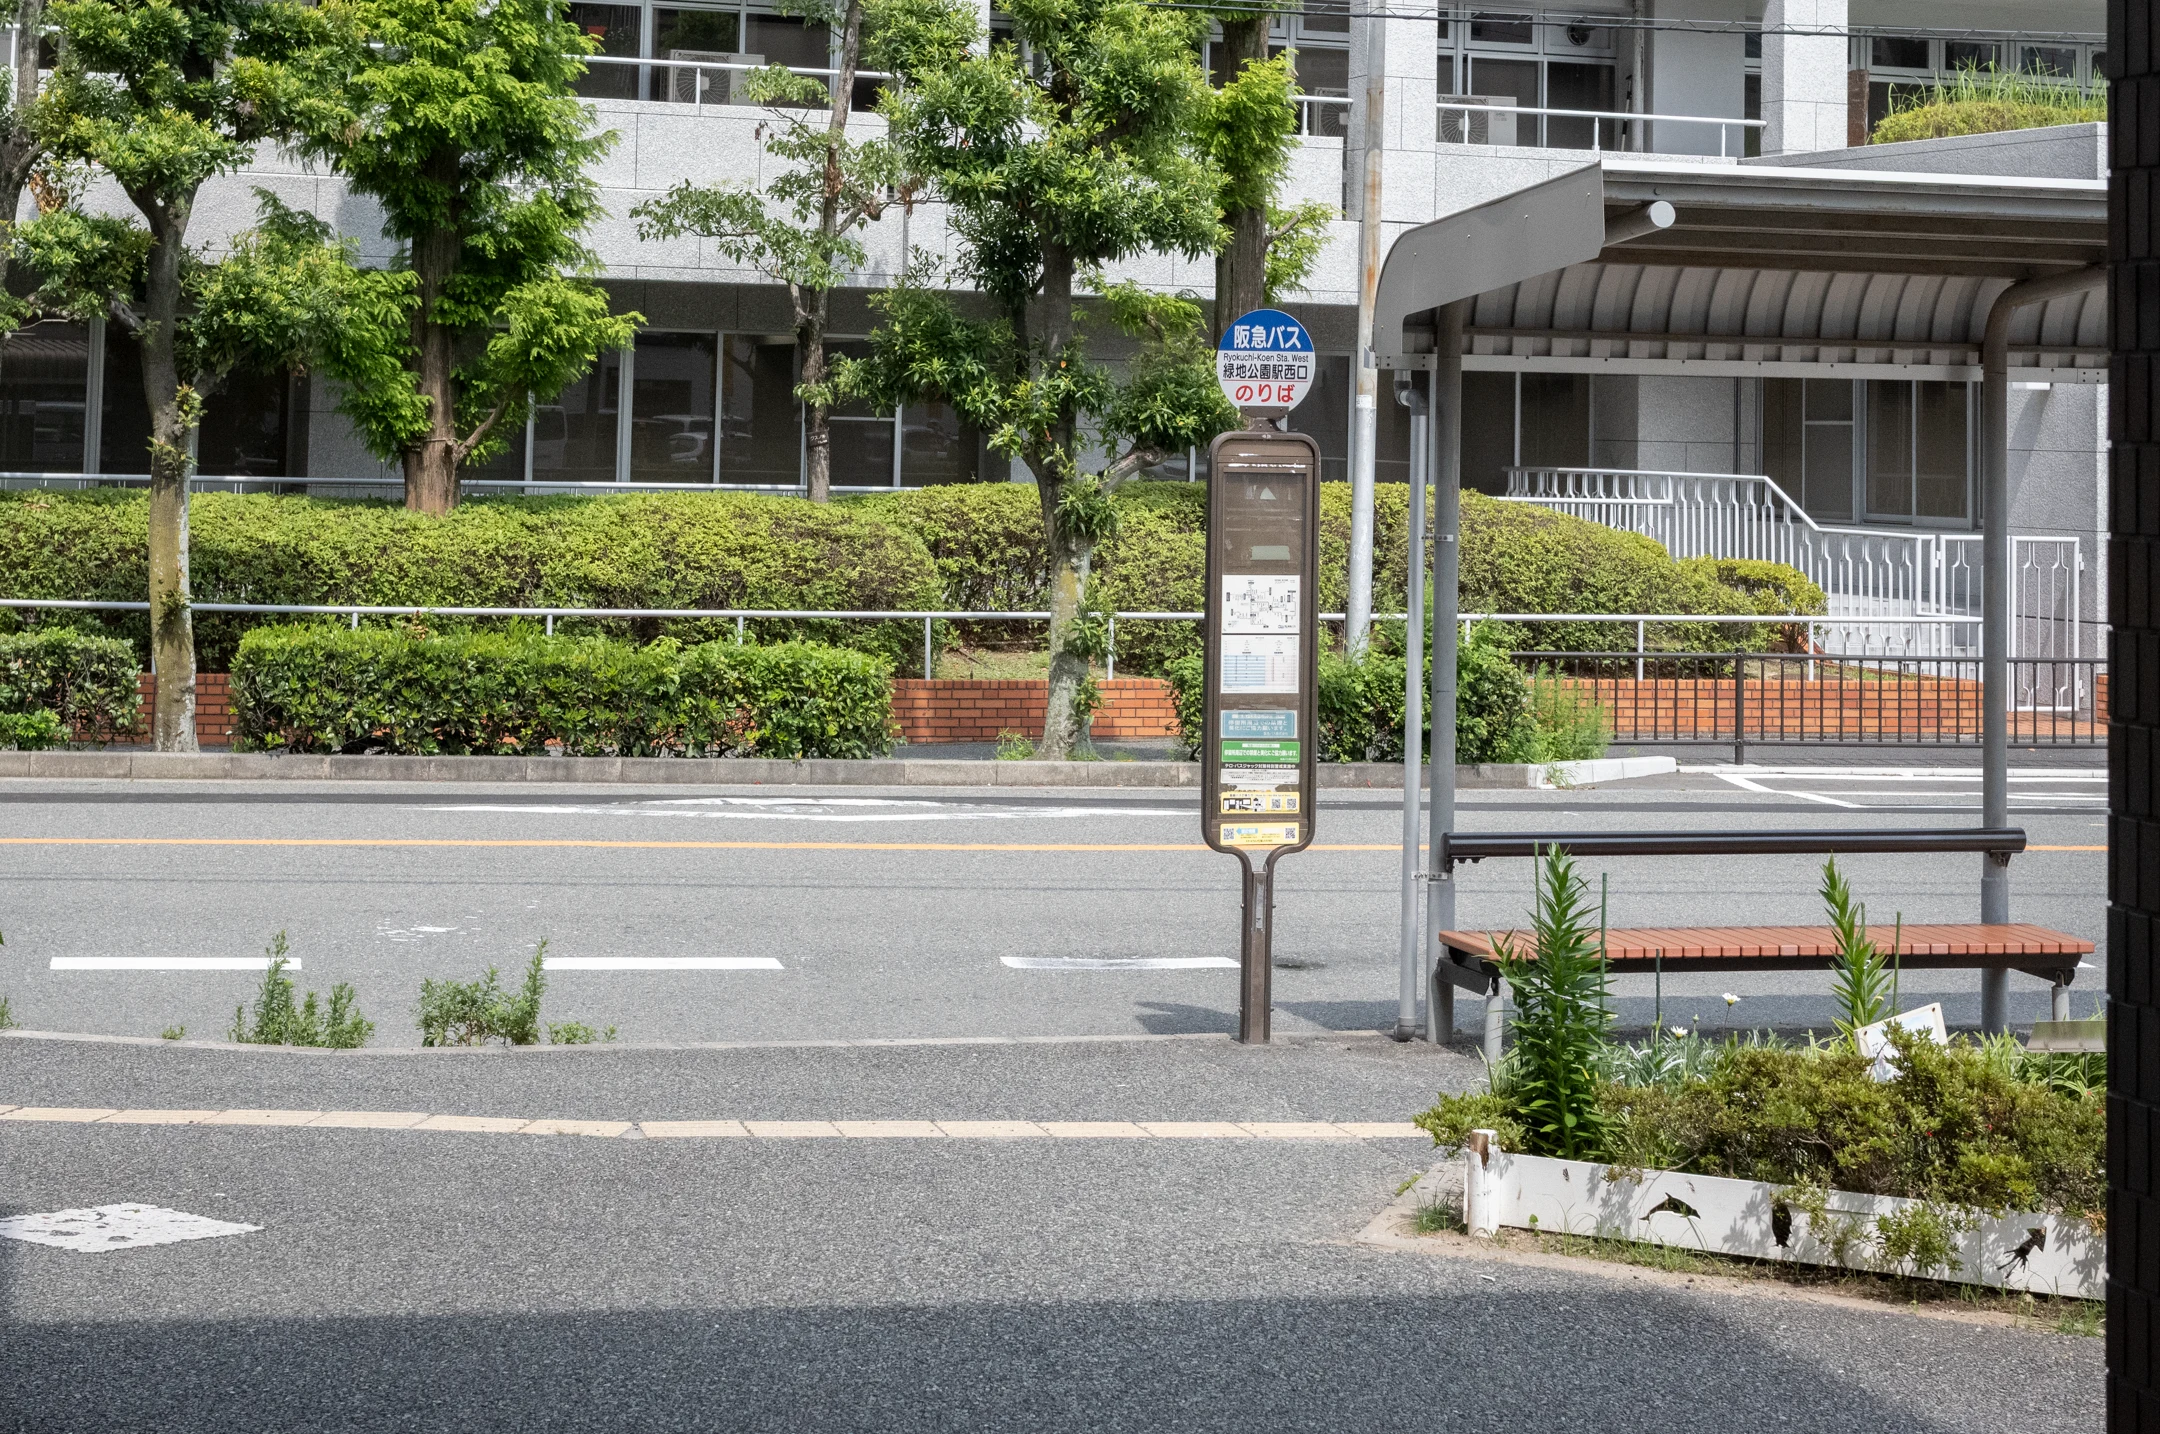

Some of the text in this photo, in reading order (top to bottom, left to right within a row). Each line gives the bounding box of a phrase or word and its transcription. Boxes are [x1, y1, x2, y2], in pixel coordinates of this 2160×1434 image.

[1234, 325, 1301, 349] 阪急バス
[1223, 353, 1309, 362] Ryokuchi-Koen Sta. West
[1223, 363, 1308, 380] 緑地公園駅西口
[1235, 384, 1296, 403] のりば
